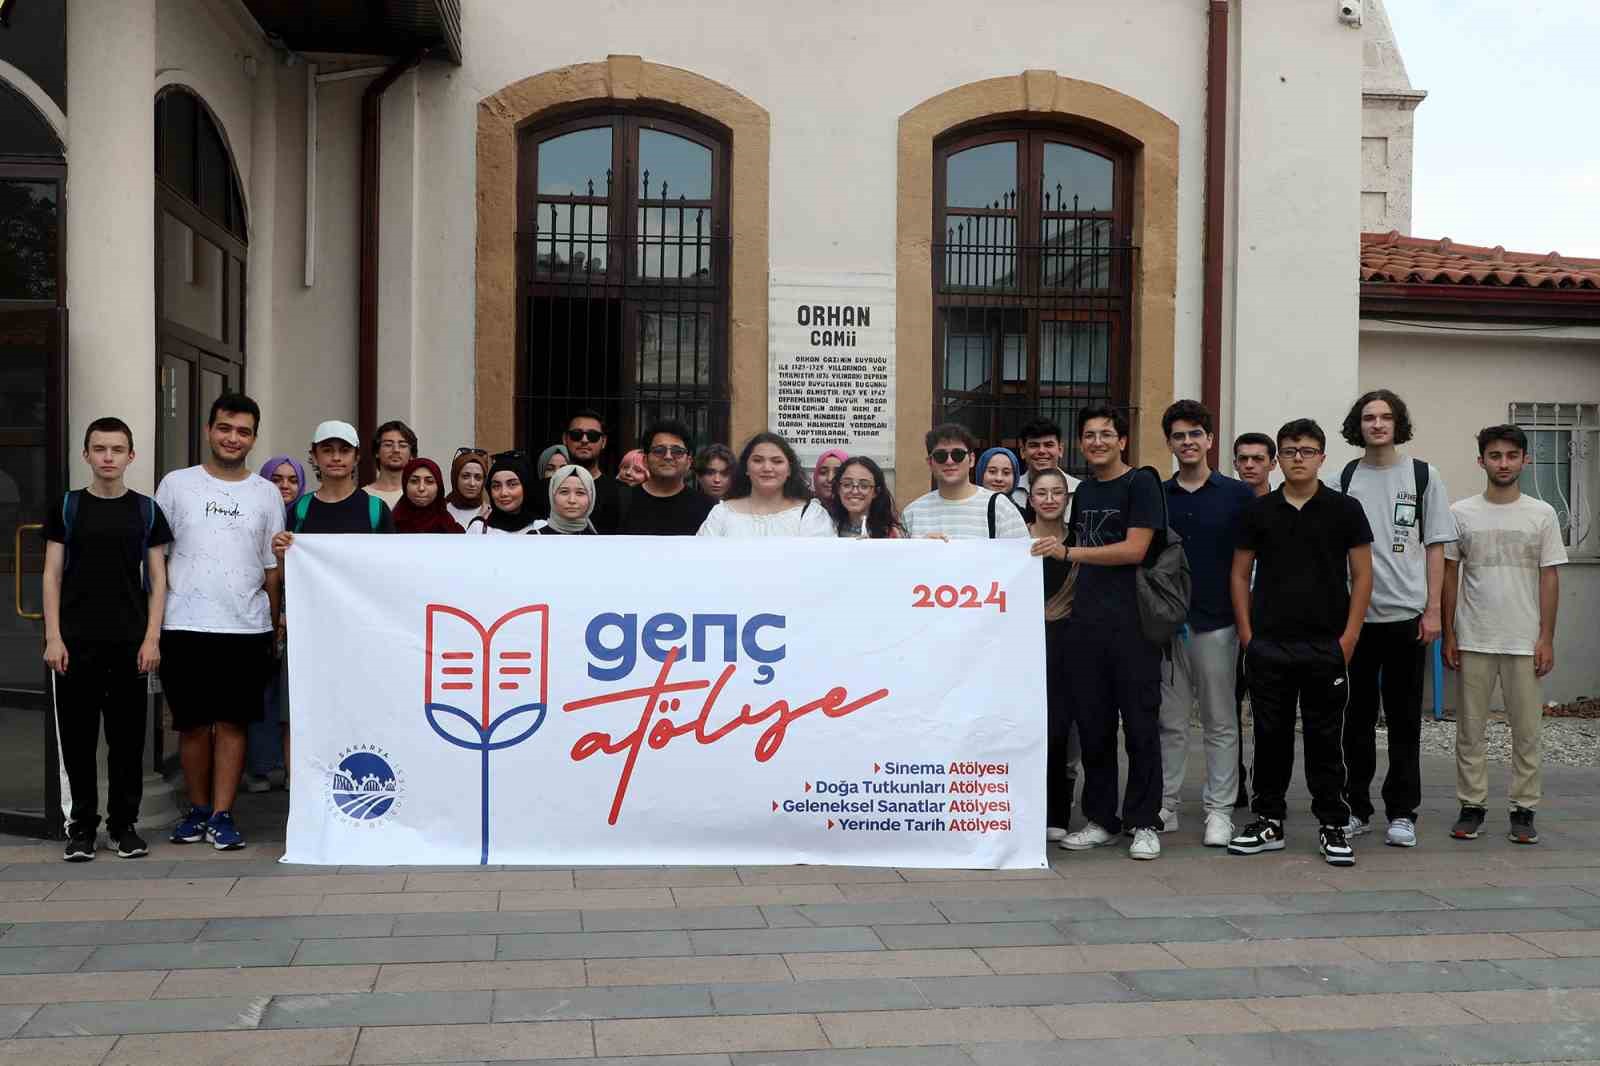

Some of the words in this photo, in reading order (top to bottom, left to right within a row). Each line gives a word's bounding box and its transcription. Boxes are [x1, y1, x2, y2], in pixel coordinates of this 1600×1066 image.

[797, 305, 870, 327] ORHAN
[911, 582, 1006, 613] 2024
[584, 610, 786, 685] genç
[562, 646, 889, 826] atölye
[884, 761, 946, 775] Sinema
[948, 761, 1009, 777] Atölyesi
[815, 780, 859, 796] Doğa
[862, 780, 946, 795] Tutkunları
[948, 780, 1009, 796] Atölyesi
[782, 799, 875, 813] Geleneksel
[877, 799, 946, 813] Sanatlar
[948, 800, 1011, 815] Atölyesi
[838, 818, 901, 832] Yerinde
[904, 818, 946, 832] Tarih
[948, 819, 1012, 834] Atölyesi
